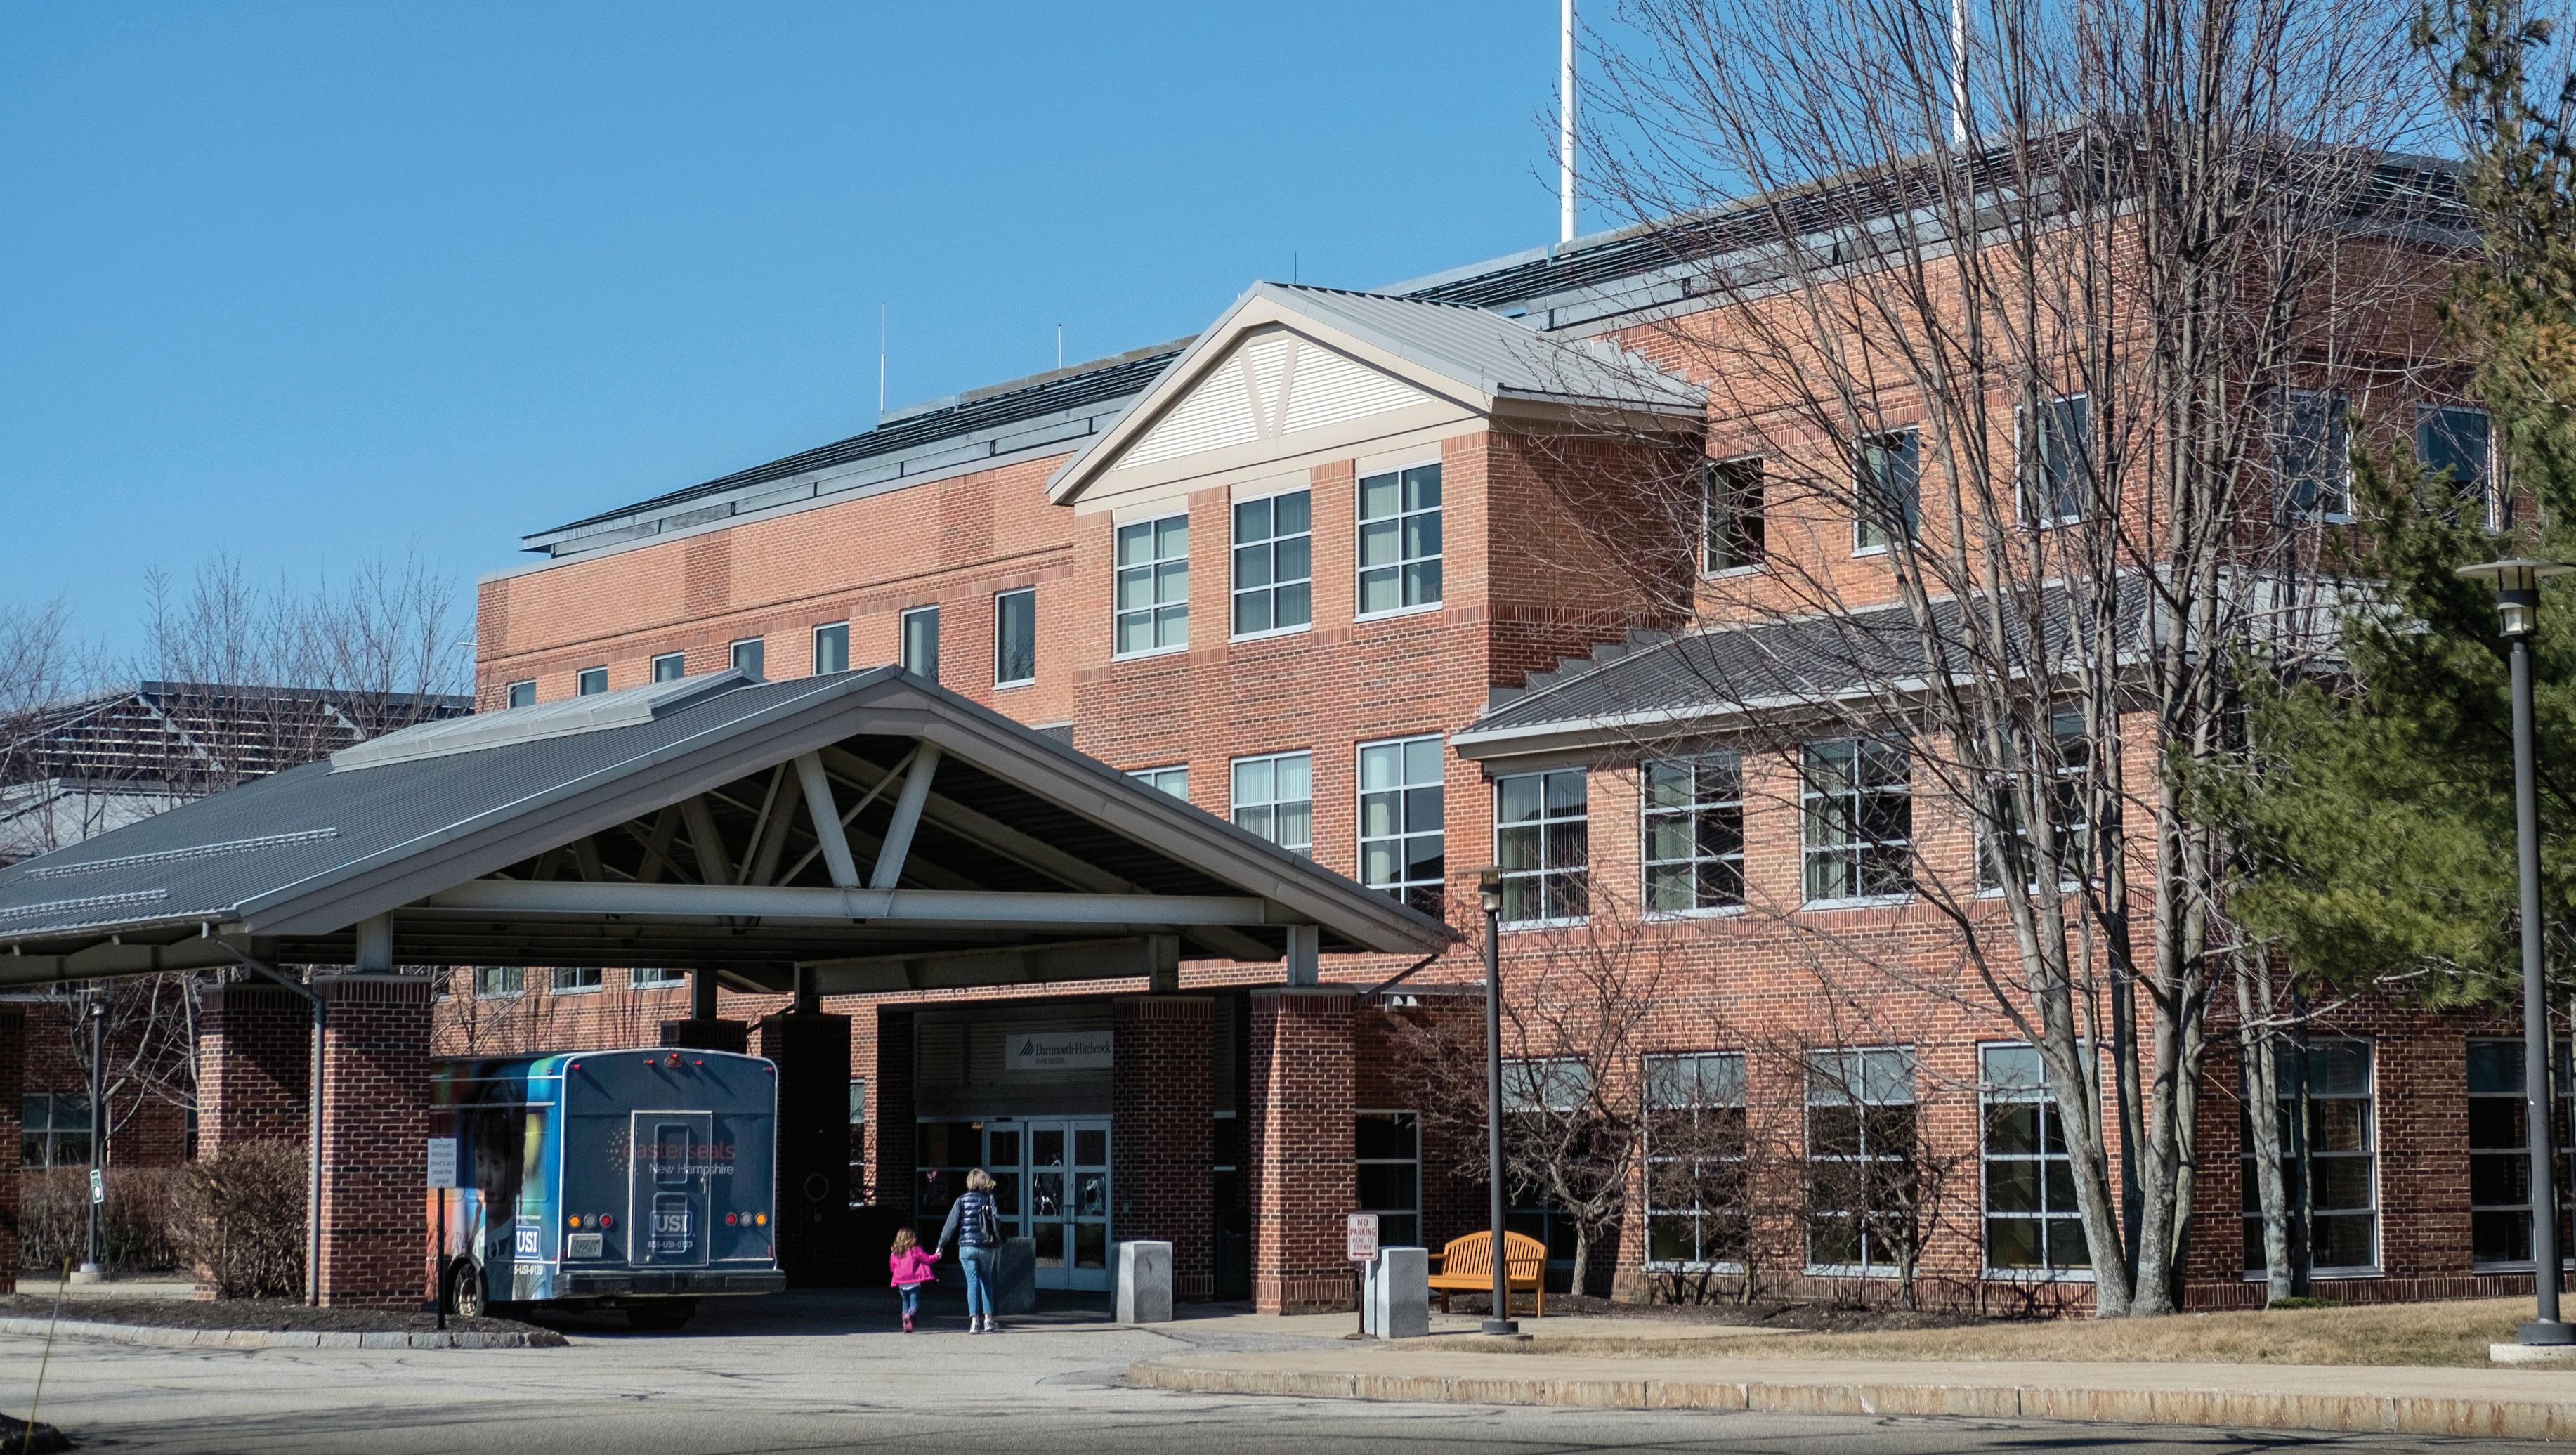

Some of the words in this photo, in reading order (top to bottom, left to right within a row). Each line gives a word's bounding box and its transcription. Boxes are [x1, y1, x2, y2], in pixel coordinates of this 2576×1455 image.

[1035, 1040, 1111, 1055] Dartmouth-Hitchcock
[622, 1141, 735, 1159] easterseals
[649, 1163, 674, 1174] New
[677, 1163, 734, 1175] Hampshire
[654, 1215, 688, 1232] USI
[1357, 1218, 1368, 1227] NO
[1350, 1227, 1375, 1237] PARKING
[516, 1230, 538, 1253] USI
